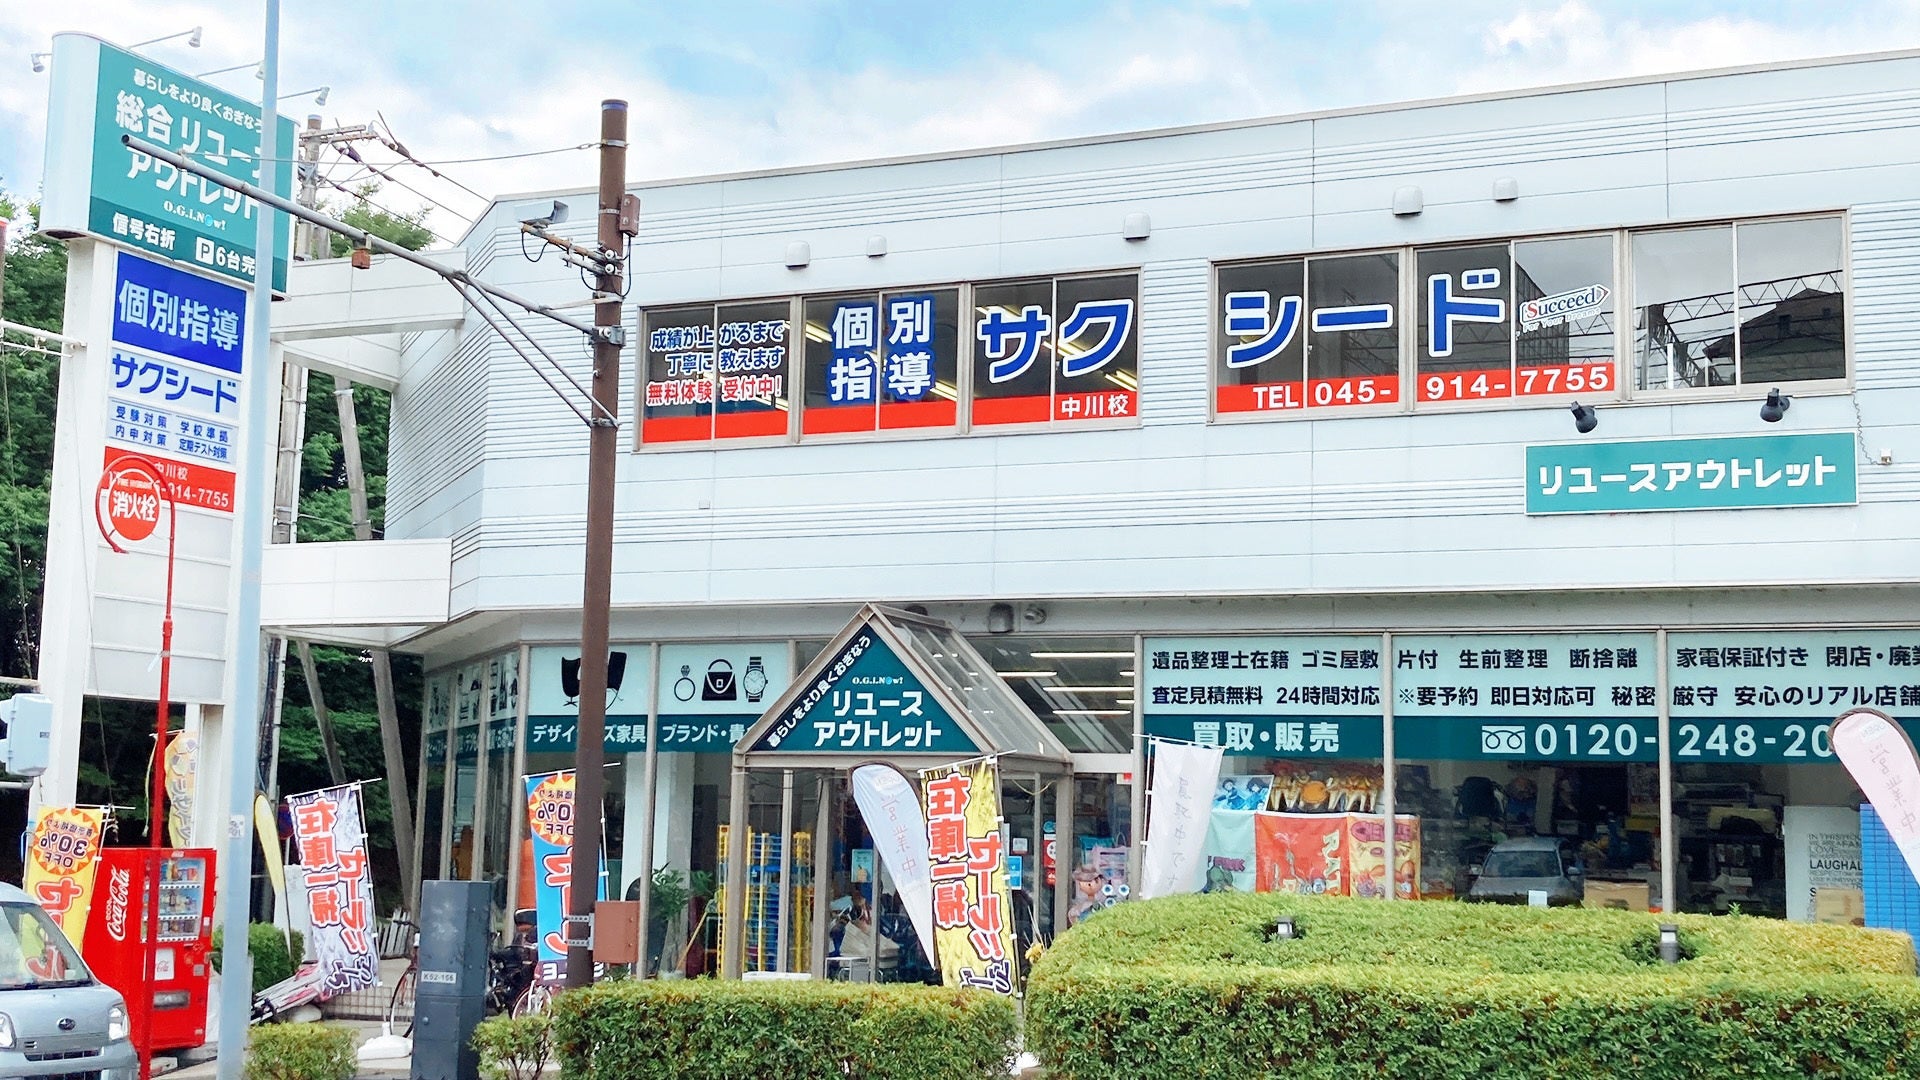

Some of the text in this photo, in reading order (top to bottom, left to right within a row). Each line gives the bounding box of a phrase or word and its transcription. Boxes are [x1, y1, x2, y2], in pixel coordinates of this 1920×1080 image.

[115, 90, 173, 145] 総合
[113, 212, 175, 251] 信号右折
[216, 243, 256, 277] 6台完
[119, 280, 239, 351] 個別指導
[1527, 288, 1595, 319] Succeed
[112, 354, 237, 413] サクシード
[1253, 385, 1299, 409] TEL
[116, 406, 167, 428] 受験対策
[1061, 395, 1129, 418] 中川校
[115, 425, 228, 459] 内申対策 定期テスト対策
[1540, 456, 1836, 495] リユースアウトレット
[112, 490, 157, 521] 消火栓
[1152, 650, 1379, 669] 遺品整理士在籍 ゴミ屋敷
[1397, 648, 1638, 669] 片付 生前整理 断捨離
[1676, 647, 1809, 668] 家電保証付き
[767, 635, 871, 748] 暮らしをより良くおぎなう
[833, 691, 923, 717] リユース
[1152, 686, 1380, 705] 査定見積無料 24時間対応
[1490, 686, 1596, 706] 即日対応可
[1611, 686, 1656, 706] 秘密
[1673, 685, 1920, 706] 厳守 安心のリアル店舗
[533, 724, 647, 744] デザイズ家具
[662, 723, 756, 744] ブランド・貴
[813, 720, 942, 747] アウトレット
[1193, 721, 1340, 752] 買取・販売
[1534, 723, 1656, 756] 0120-
[1678, 724, 1831, 757] 248-20
[106, 864, 130, 941] Coca-Cola
